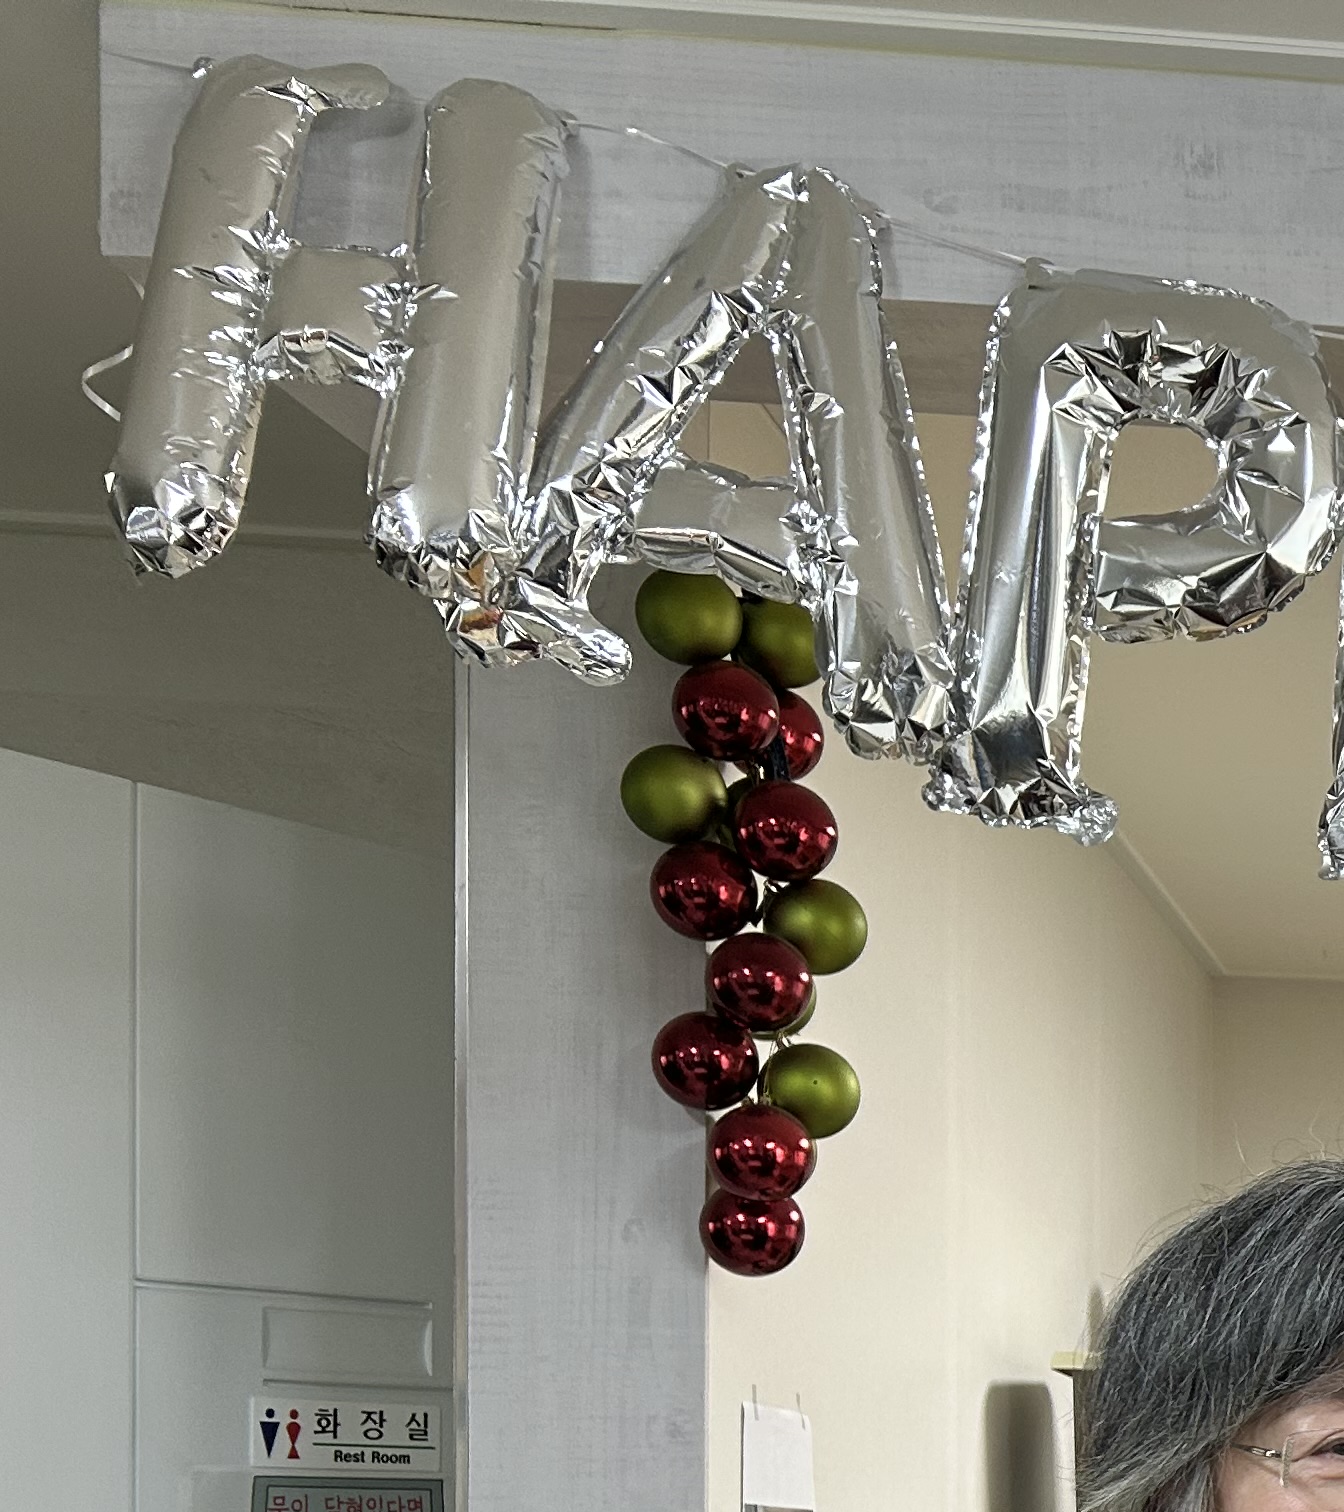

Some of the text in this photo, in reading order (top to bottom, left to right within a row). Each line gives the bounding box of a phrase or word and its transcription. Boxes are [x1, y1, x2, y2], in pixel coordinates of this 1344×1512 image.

[313, 1407, 430, 1442] 화장실
[334, 1449, 411, 1465] Rest Room
